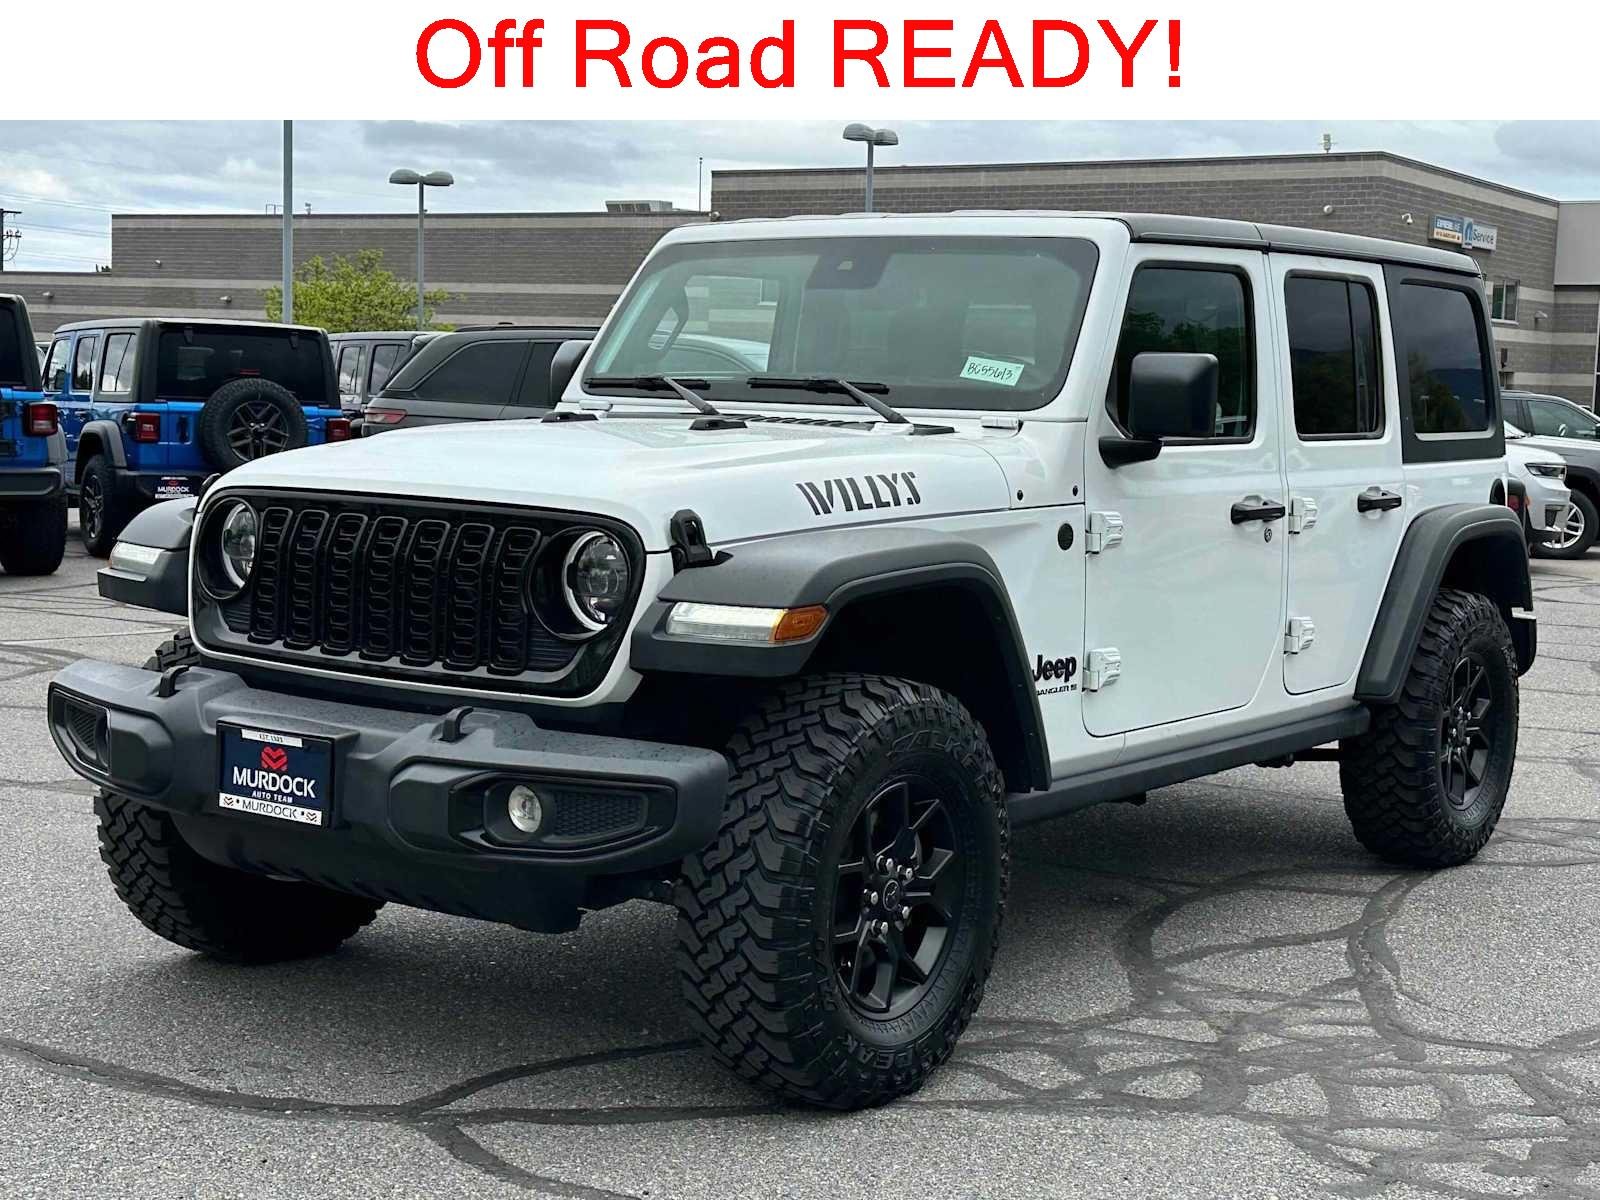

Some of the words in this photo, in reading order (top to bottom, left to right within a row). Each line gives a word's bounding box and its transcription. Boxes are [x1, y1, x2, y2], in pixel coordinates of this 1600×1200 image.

[1472, 228, 1495, 245] Service
[795, 471, 922, 516] WILLYS
[1031, 654, 1077, 683] Jeep
[232, 766, 316, 799] MURDOCK
[242, 799, 298, 819] MURDOCK
[252, 790, 272, 800] AUTO
[274, 794, 294, 804] TEAM
